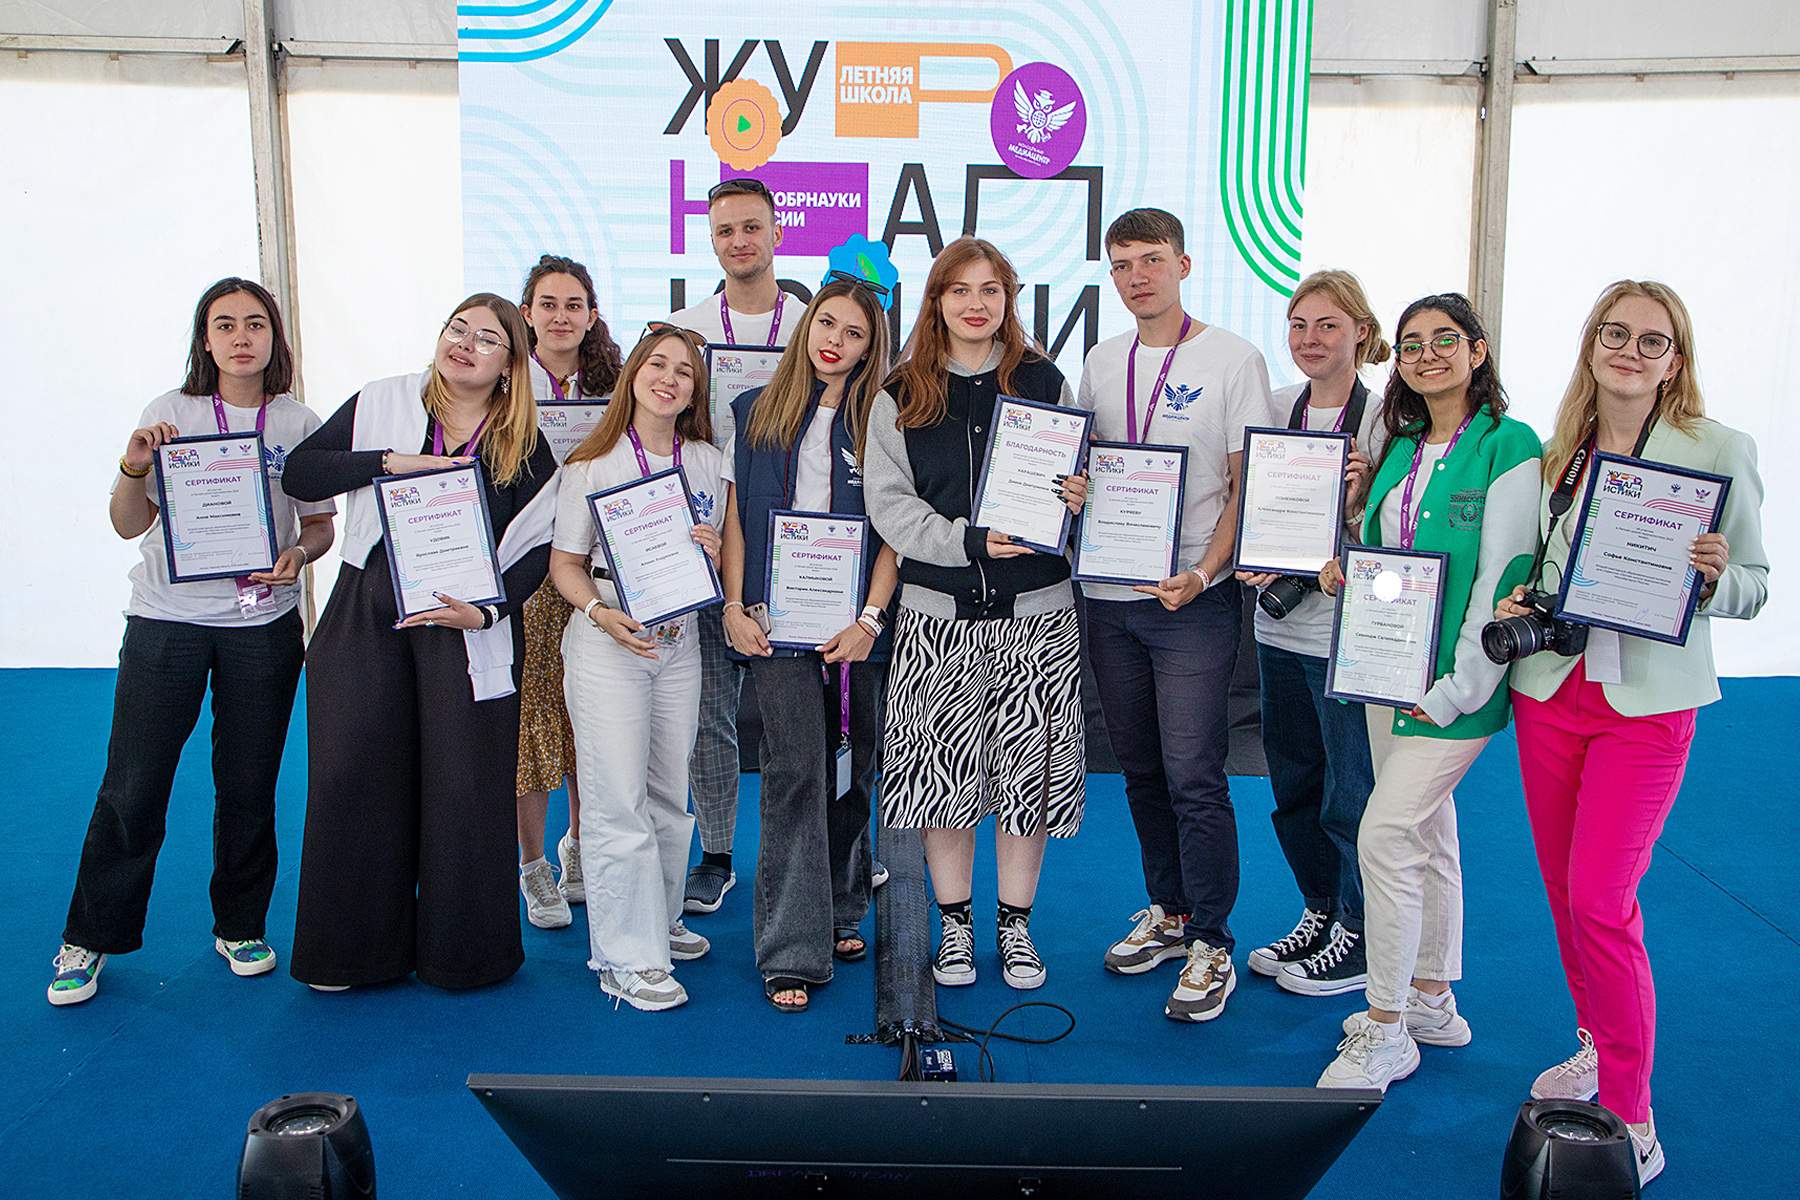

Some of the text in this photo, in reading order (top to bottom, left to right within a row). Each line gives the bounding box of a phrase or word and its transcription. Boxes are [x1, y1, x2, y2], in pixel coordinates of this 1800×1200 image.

[840, 65, 914, 85] ЛЕТНЯЯ
[840, 86, 912, 104] ШКОЛА
[770, 191, 862, 208] ОБРНАУКИ
[1005, 440, 1067, 458] БЛАГОДАРНОСТЬ
[1267, 471, 1321, 481] СЕРТИФИКАТ
[1564, 449, 1587, 486] Canon
[185, 475, 242, 487] СЕРТИФИКАТ
[1106, 484, 1159, 495] СЕРТИФИКАТ
[407, 508, 463, 525] СЕРТИФИКАТ
[1614, 510, 1683, 531] СЕРТИФИКАТ
[623, 515, 674, 537] СЕРТИФИКАТ
[791, 551, 842, 561] СЕРТИФИКАТ
